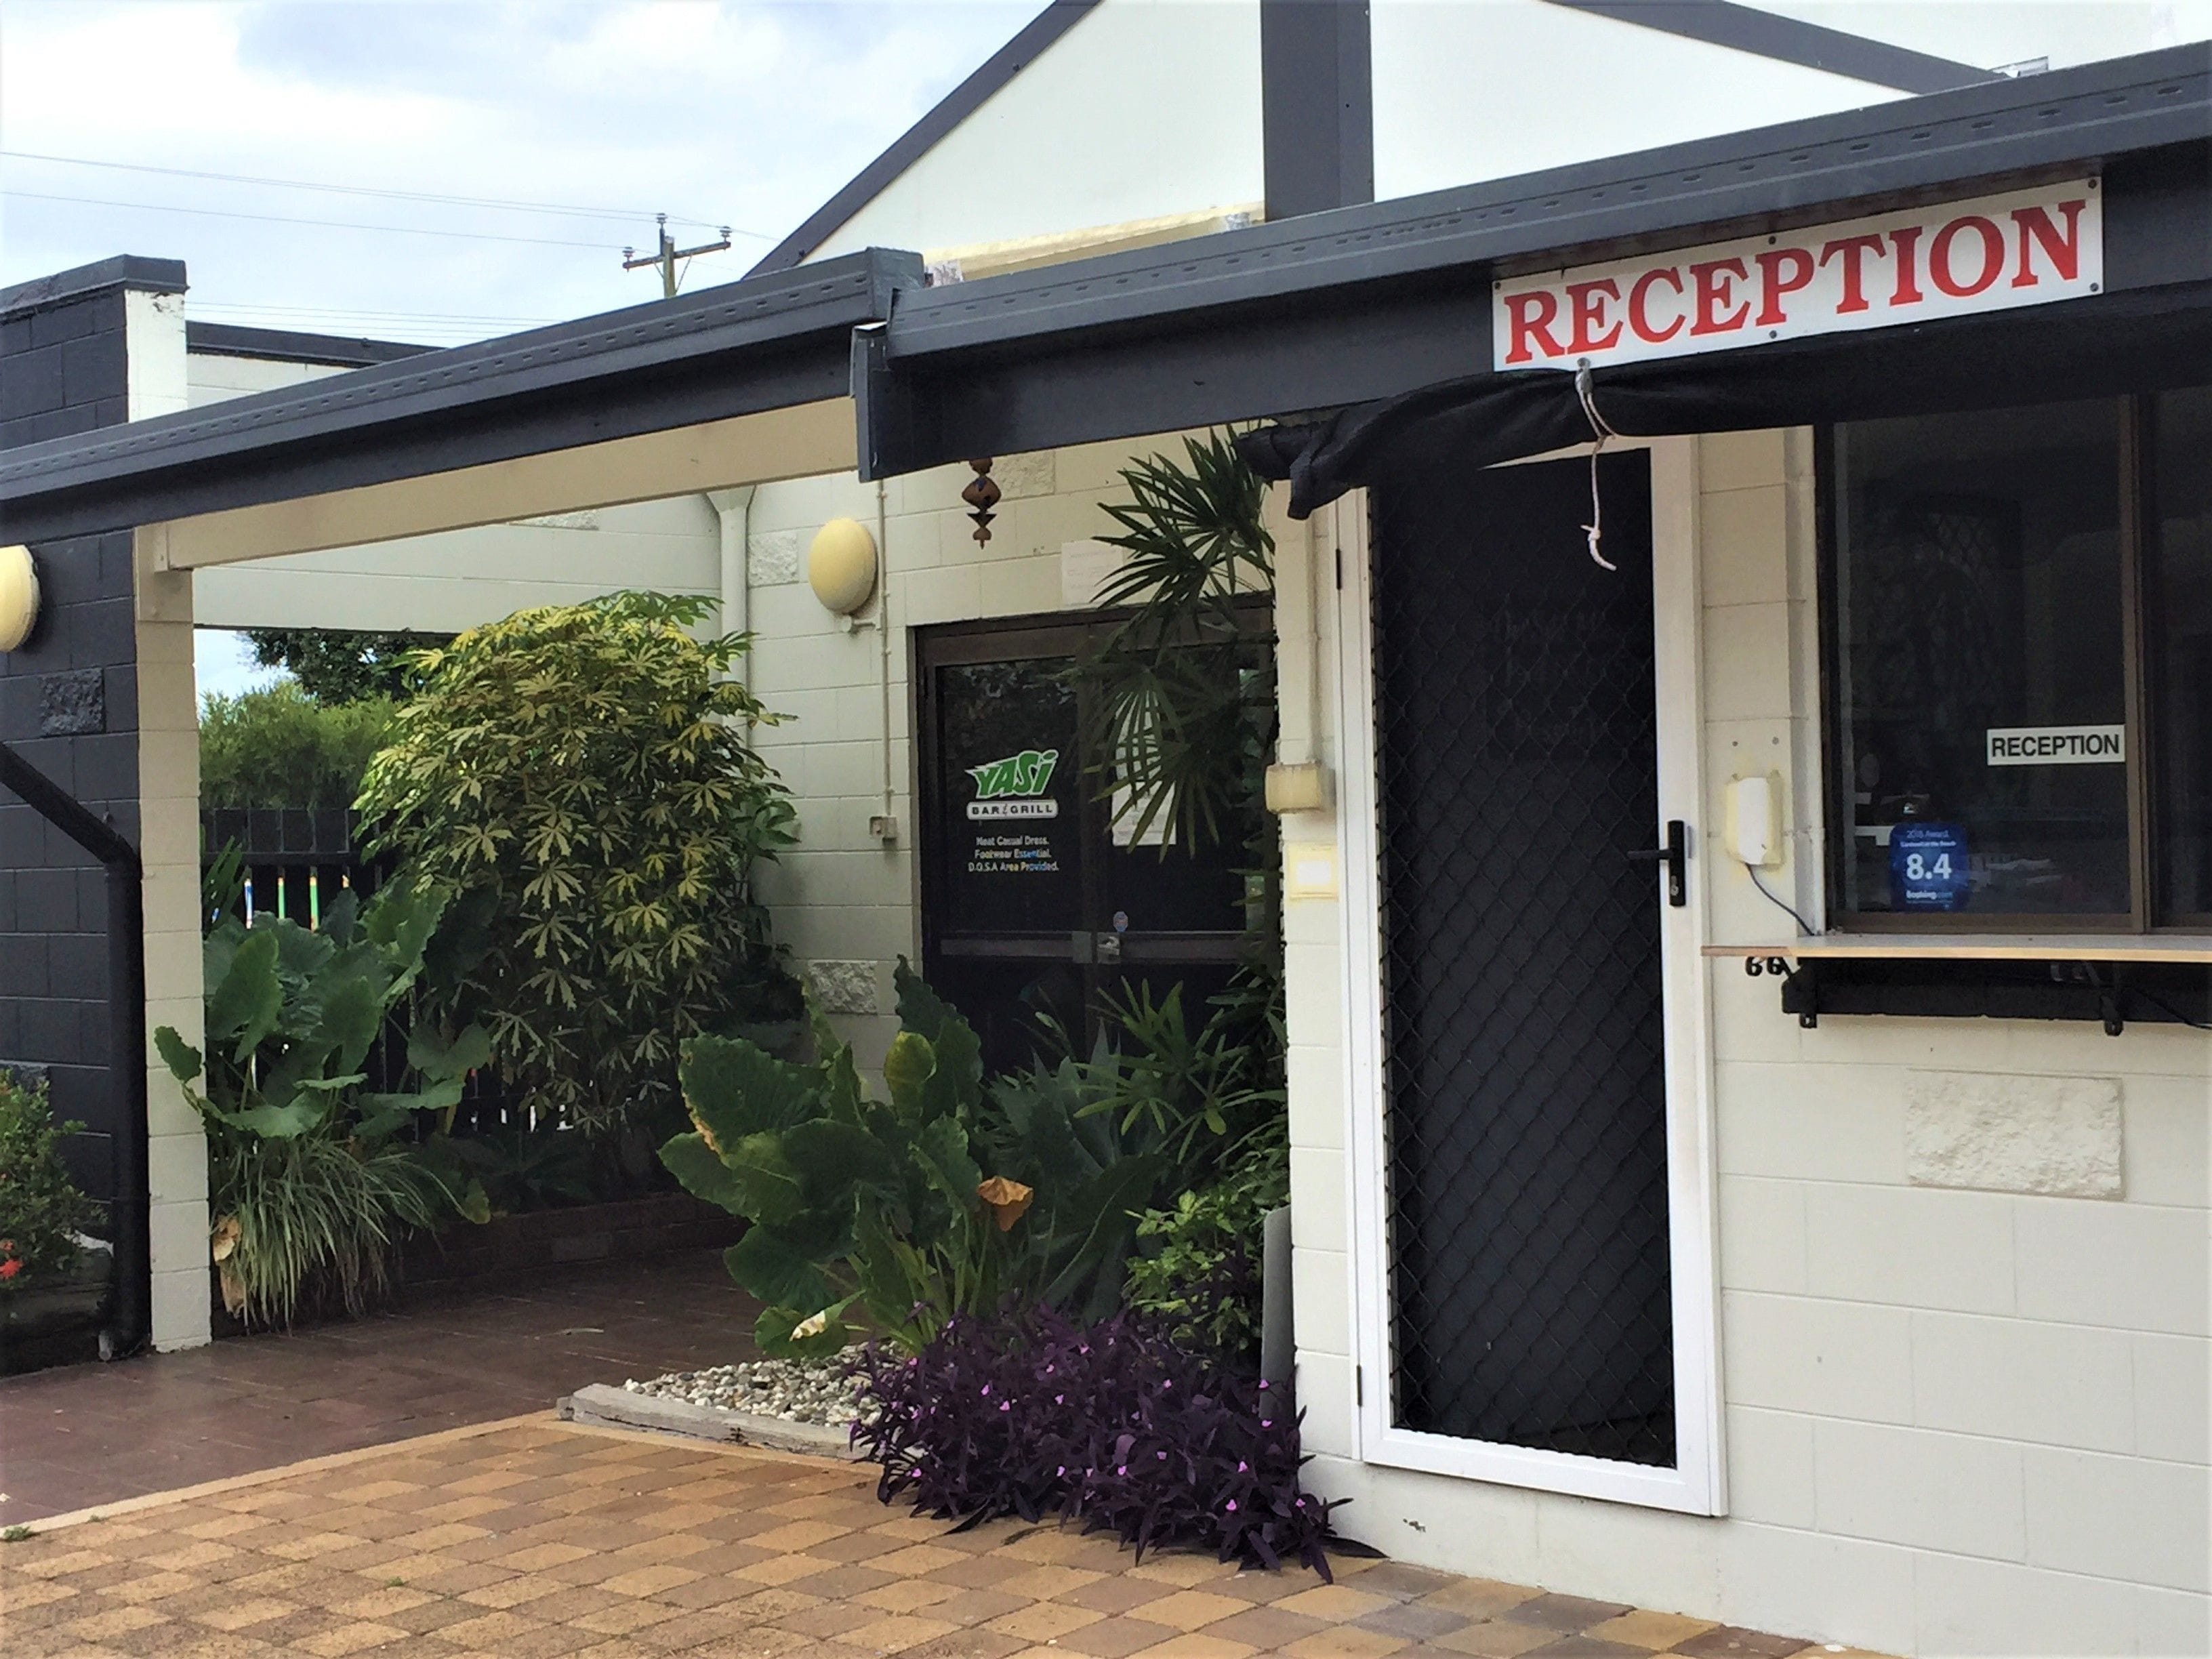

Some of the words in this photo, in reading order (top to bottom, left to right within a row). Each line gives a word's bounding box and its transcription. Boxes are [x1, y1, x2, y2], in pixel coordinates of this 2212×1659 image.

[1503, 199, 2086, 364] RECEPTION
[1991, 734, 2120, 757] RECEPTION
[972, 806, 1000, 815] BAR
[1010, 804, 1053, 814] GRILL
[976, 836, 995, 846] Neat
[997, 836, 1023, 845] Casual
[1025, 836, 1050, 844] Dress.
[975, 849, 1012, 859] Footwear
[1014, 848, 1052, 858] Essential.
[1000, 862, 1019, 871] Area
[1021, 861, 1059, 871] Provided.
[1906, 853, 1952, 880] 8.4
